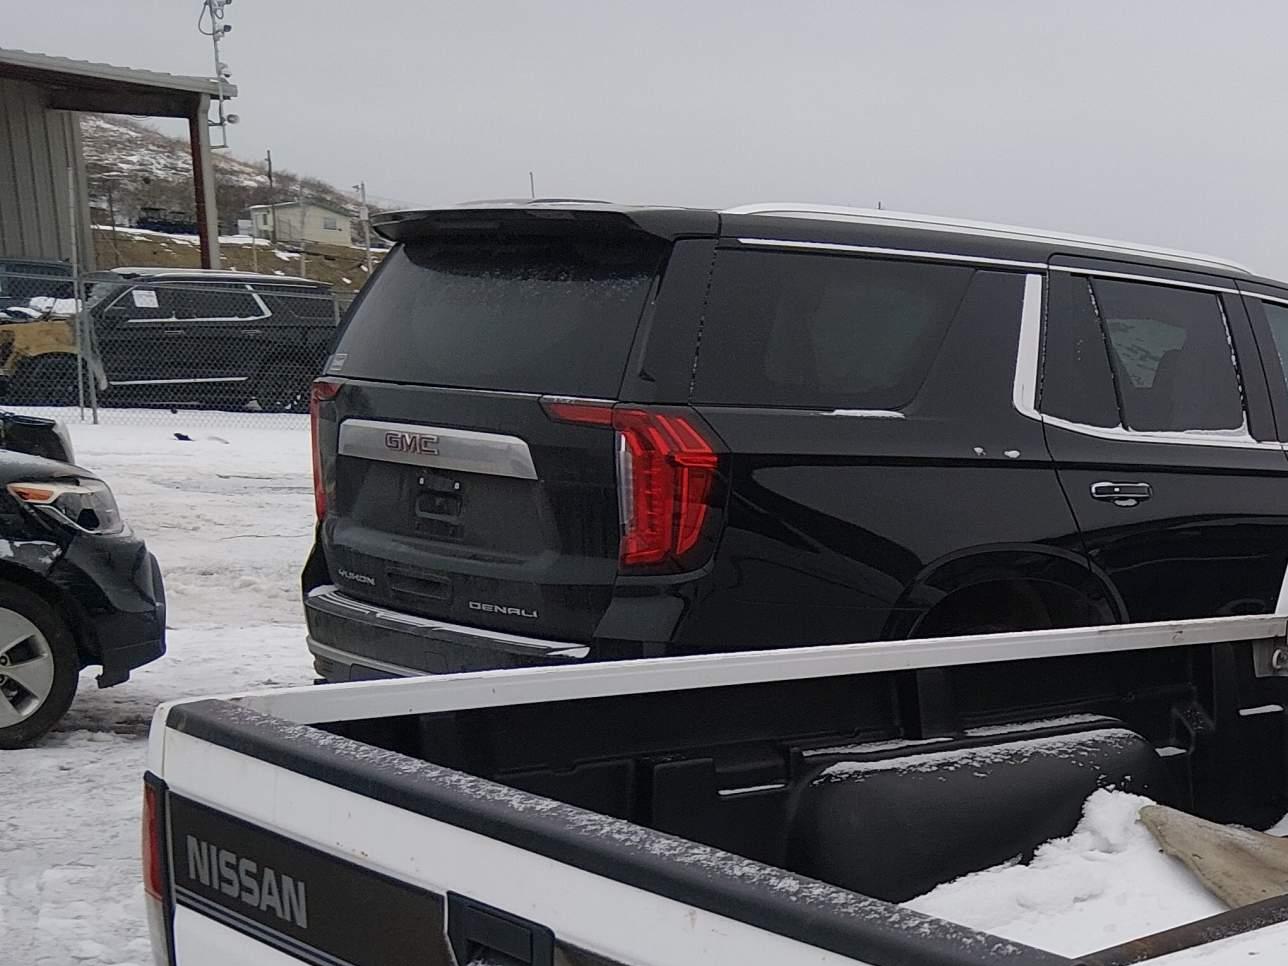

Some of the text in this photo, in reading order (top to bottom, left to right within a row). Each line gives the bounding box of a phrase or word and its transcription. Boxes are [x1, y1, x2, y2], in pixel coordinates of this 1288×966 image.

[385, 432, 439, 456] GMC
[338, 568, 376, 586] YUKON
[469, 601, 538, 618] DENALI
[186, 834, 307, 929] NISSAN
